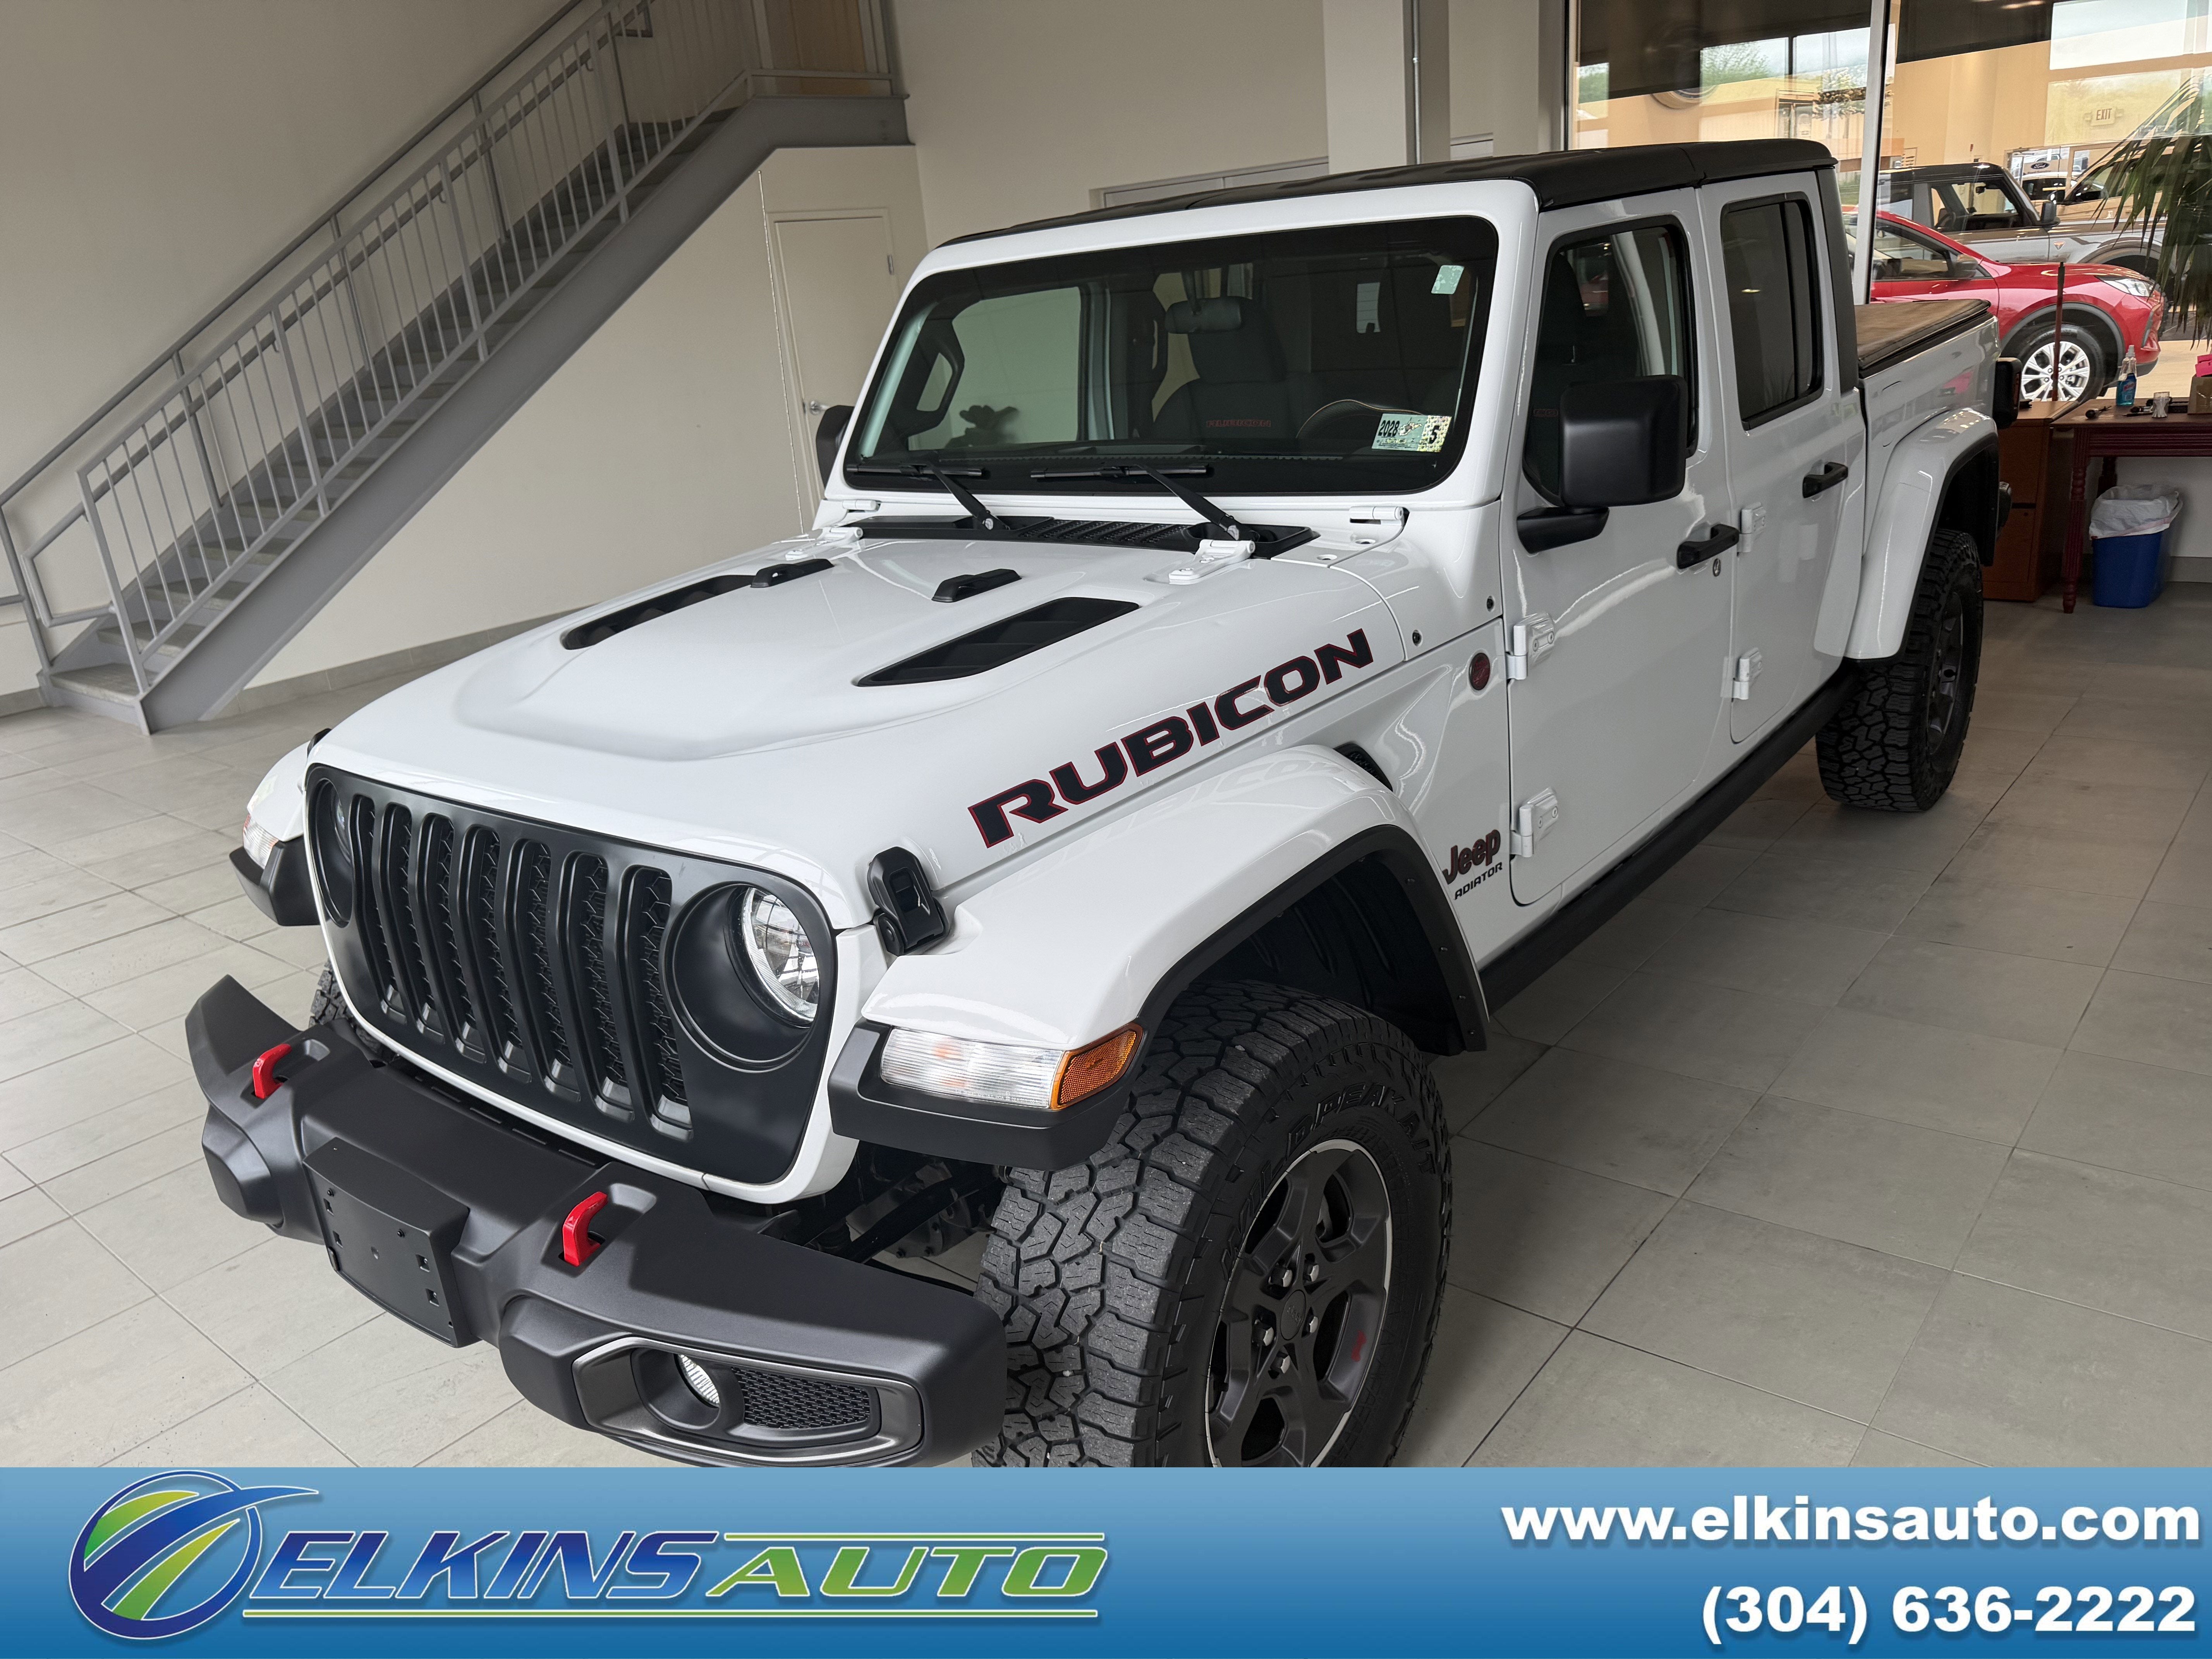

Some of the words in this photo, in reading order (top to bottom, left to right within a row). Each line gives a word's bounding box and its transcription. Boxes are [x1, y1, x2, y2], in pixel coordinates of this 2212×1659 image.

[2096, 108, 2112, 120] EXIT
[1377, 420, 1400, 436] 2028
[1429, 425, 1440, 444] 5
[967, 628, 1374, 848] RUBICON
[1442, 829, 1501, 885] Jeep
[1454, 862, 1503, 900] ADIATOR
